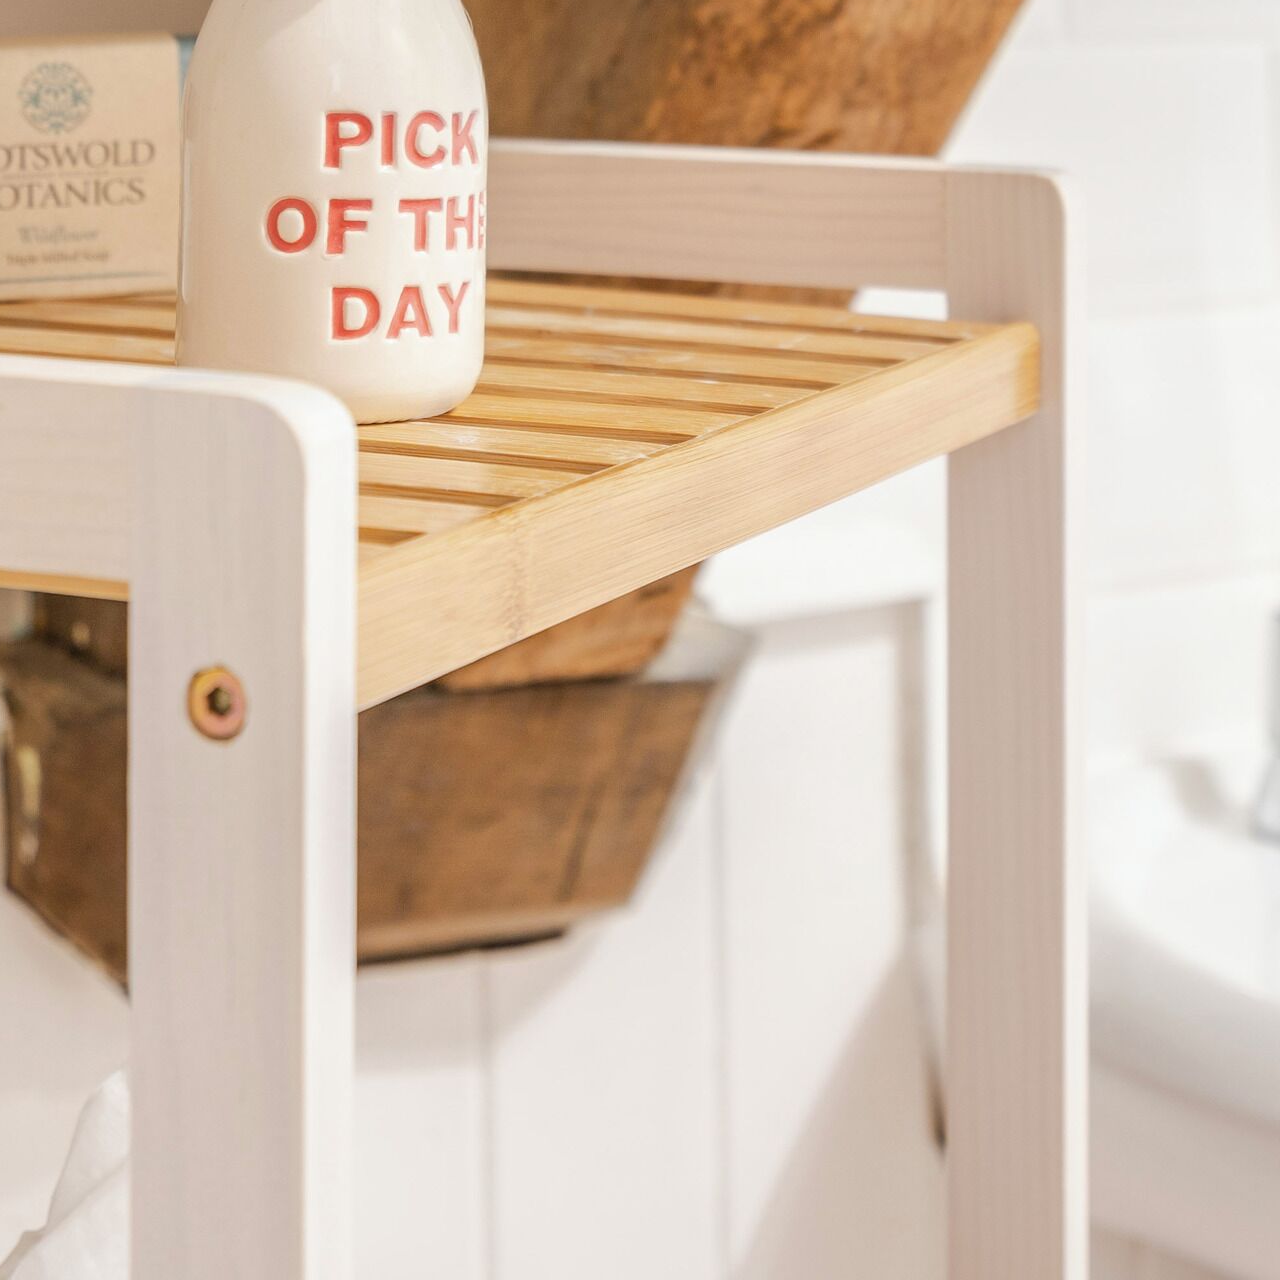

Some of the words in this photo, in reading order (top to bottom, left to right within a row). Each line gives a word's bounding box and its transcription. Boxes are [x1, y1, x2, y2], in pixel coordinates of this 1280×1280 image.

[323, 109, 481, 169] PICK
[266, 197, 374, 255] OF
[331, 280, 471, 341] DAY
